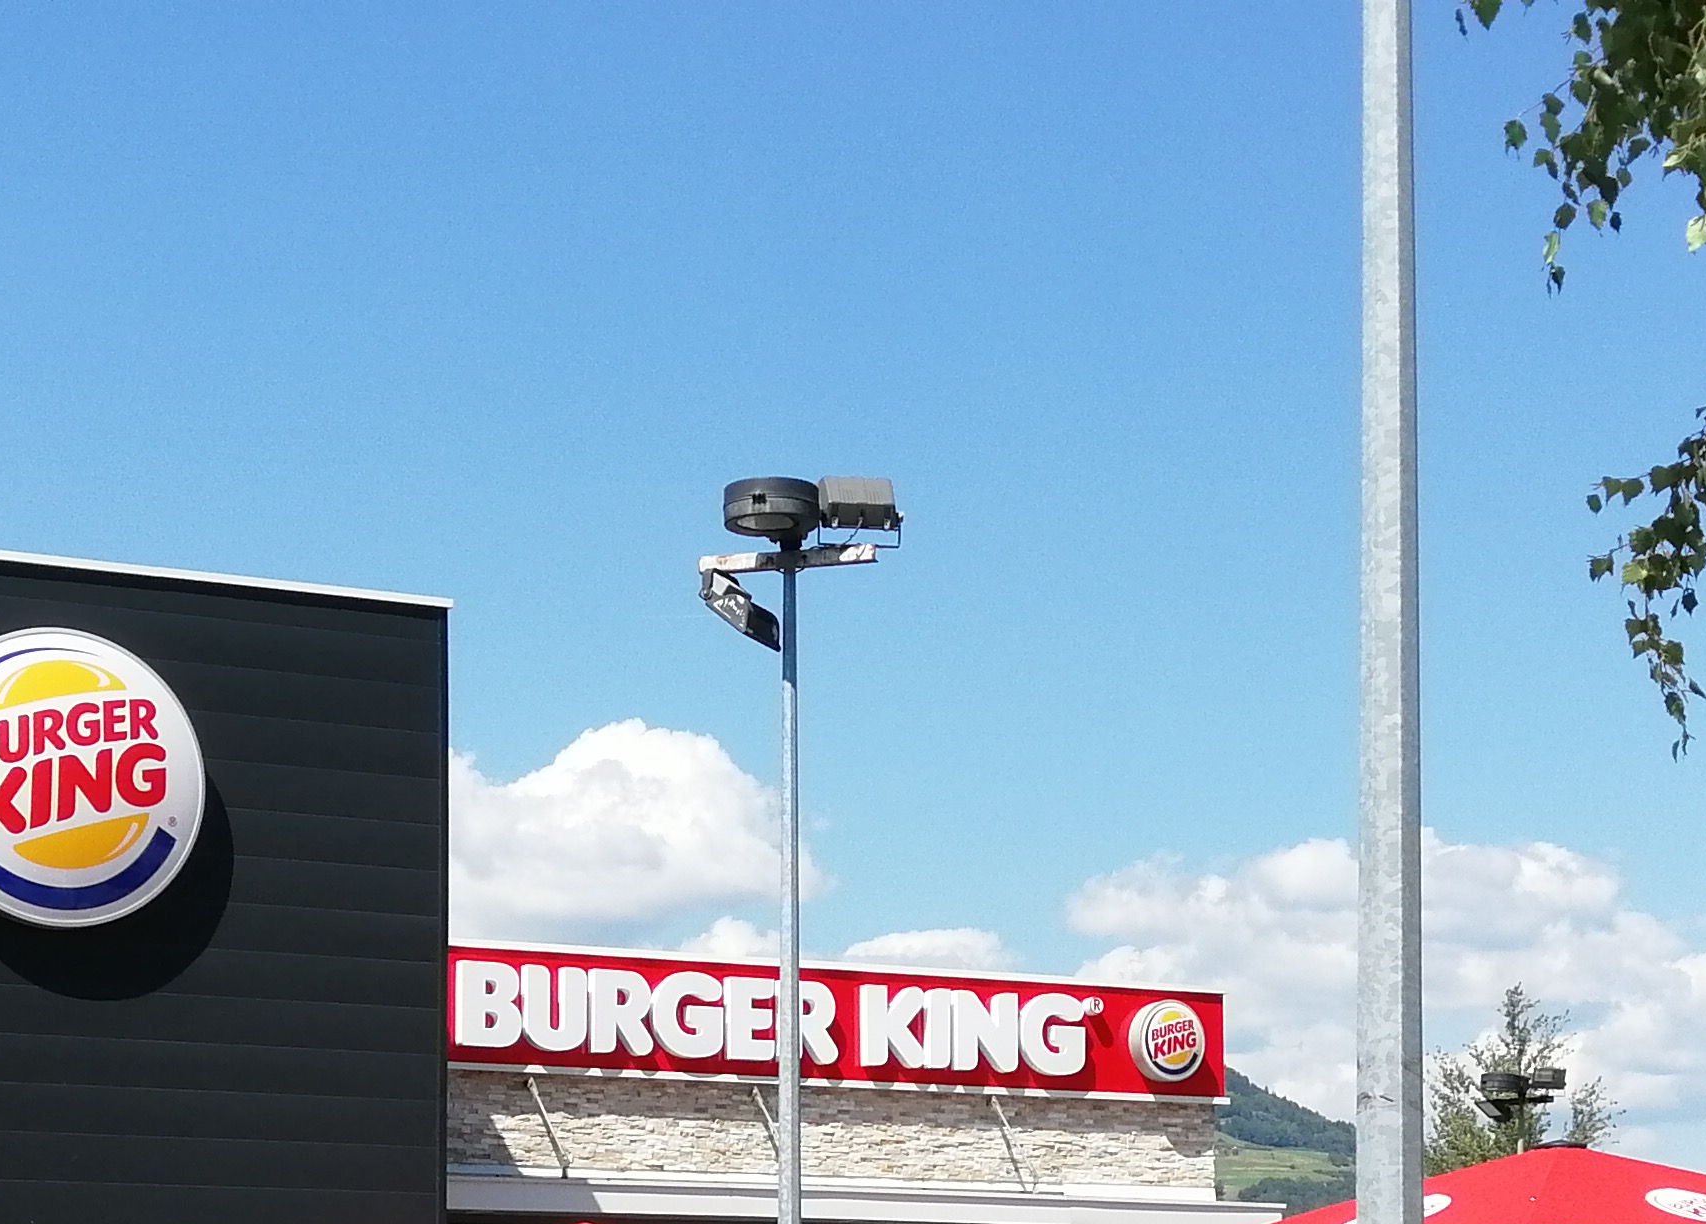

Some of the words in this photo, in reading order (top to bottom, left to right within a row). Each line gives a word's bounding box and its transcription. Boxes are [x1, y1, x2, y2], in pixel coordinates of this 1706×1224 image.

[455, 959, 839, 1065] BURGER
[1151, 1019, 1195, 1042] BURGER
[1153, 1031, 1197, 1059] KING
